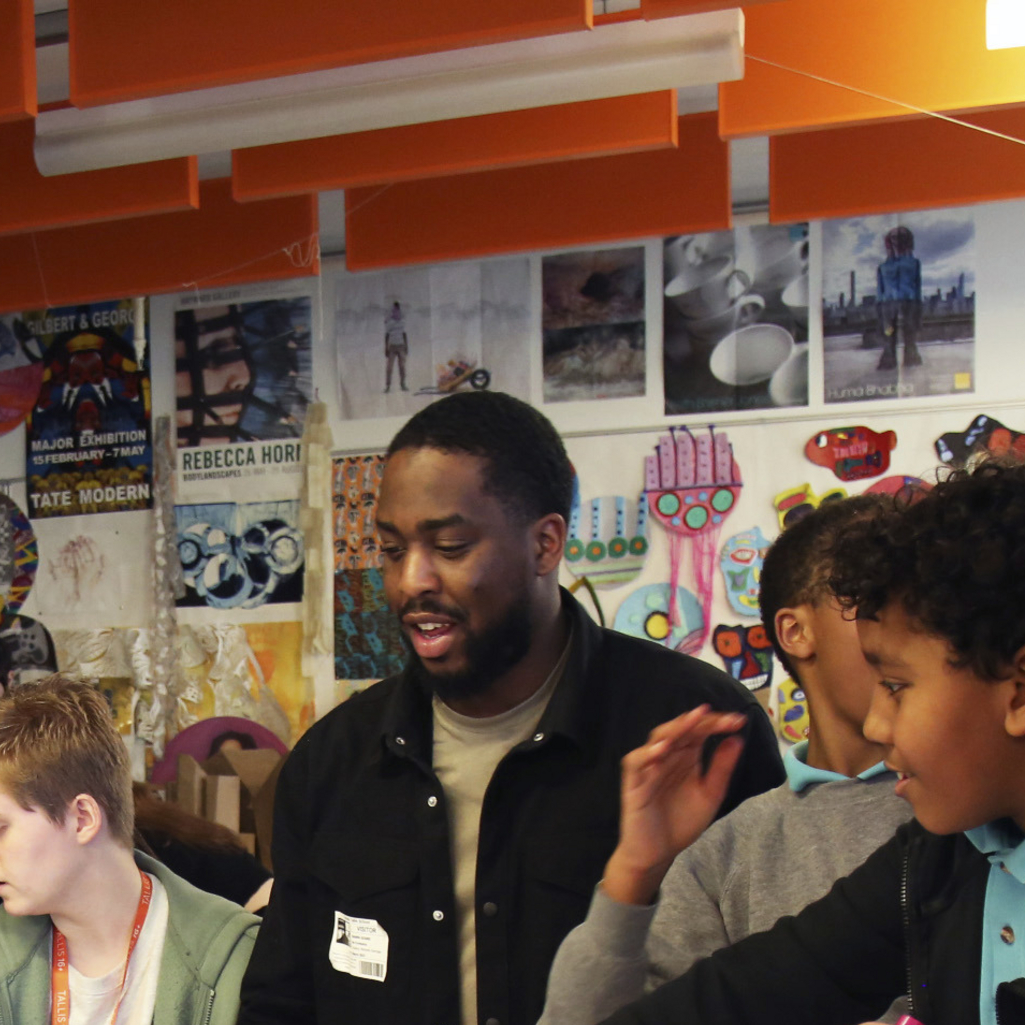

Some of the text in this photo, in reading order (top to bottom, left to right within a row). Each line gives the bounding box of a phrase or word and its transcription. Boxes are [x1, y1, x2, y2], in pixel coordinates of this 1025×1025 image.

[27, 315, 76, 335] GILBERT
[79, 313, 89, 330] &
[31, 430, 147, 452] MAJOR EXHIBITION
[45, 449, 106, 464] FEBRUARY
[120, 445, 146, 456] MAY
[183, 447, 256, 471] REBECCA
[30, 484, 150, 509] TATE MODERN
[57, 990, 66, 1023] TALLIS
